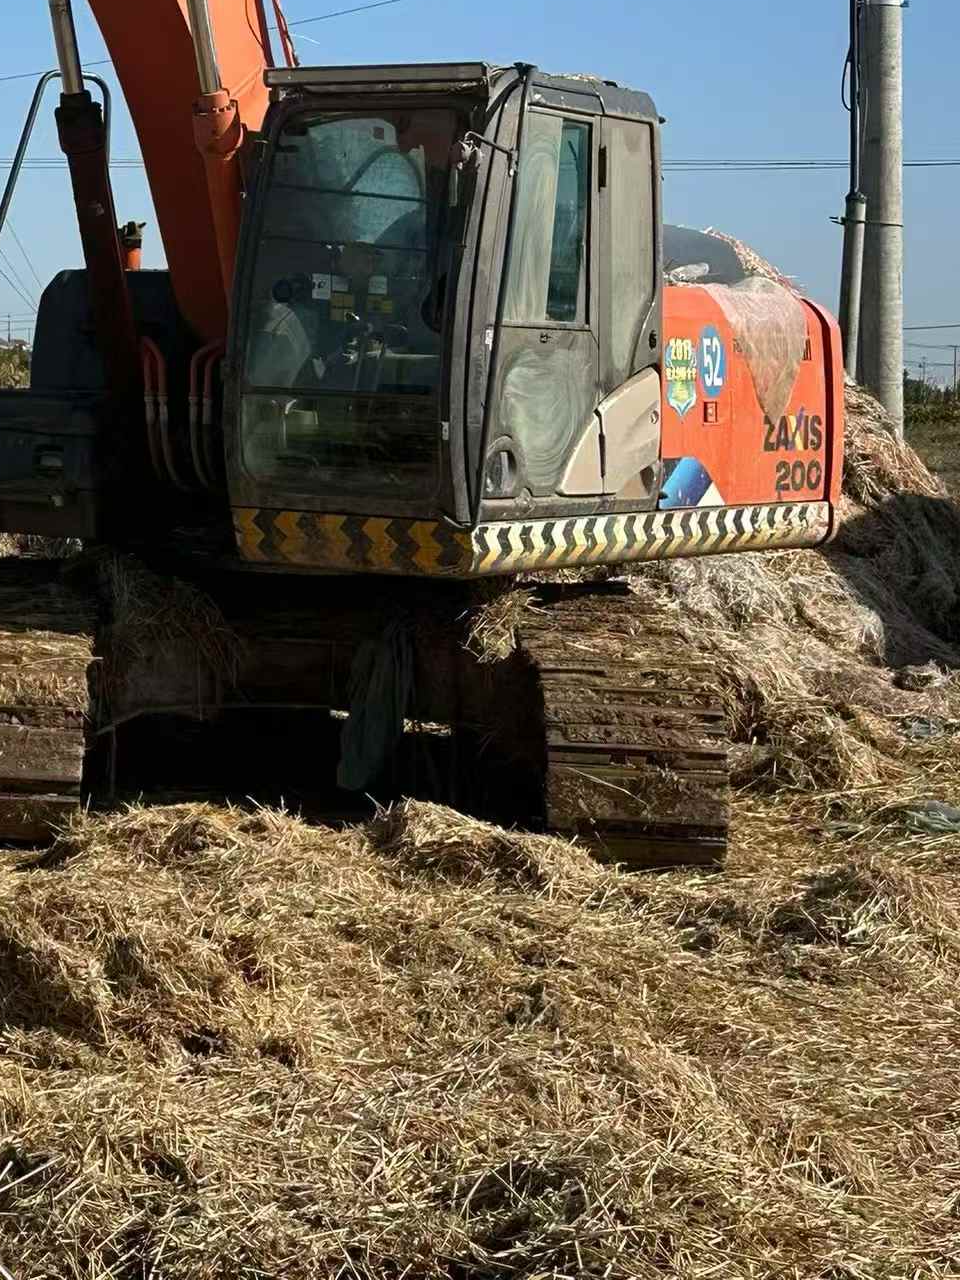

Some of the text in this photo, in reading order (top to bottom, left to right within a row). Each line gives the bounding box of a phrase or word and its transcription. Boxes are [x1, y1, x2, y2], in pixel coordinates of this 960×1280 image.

[702, 336, 723, 387] 52
[763, 407, 822, 452] ZAXIS
[775, 460, 822, 491] 200
